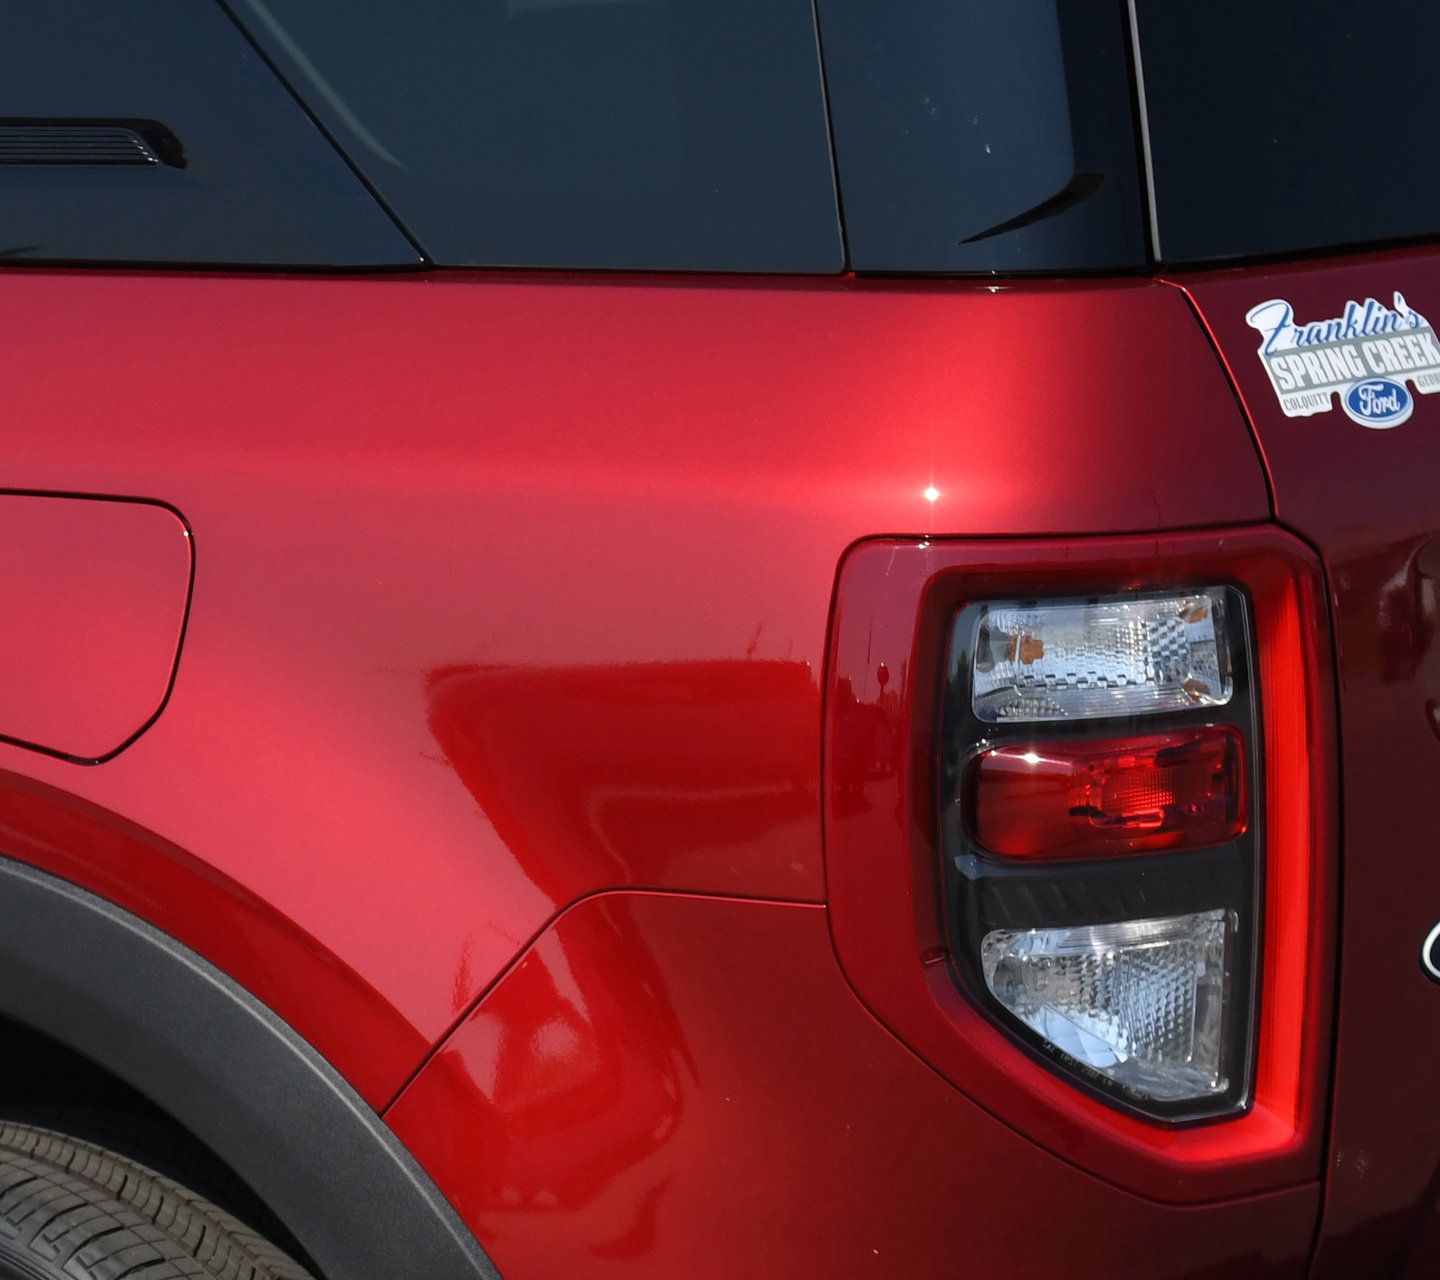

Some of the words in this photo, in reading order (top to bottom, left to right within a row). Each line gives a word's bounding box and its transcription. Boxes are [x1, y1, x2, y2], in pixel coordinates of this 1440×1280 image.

[1250, 293, 1421, 356] Franklin's
[1269, 344, 1365, 390] SPRING
[1282, 392, 1330, 412] COLQUITT
[1358, 383, 1401, 416] Ford
